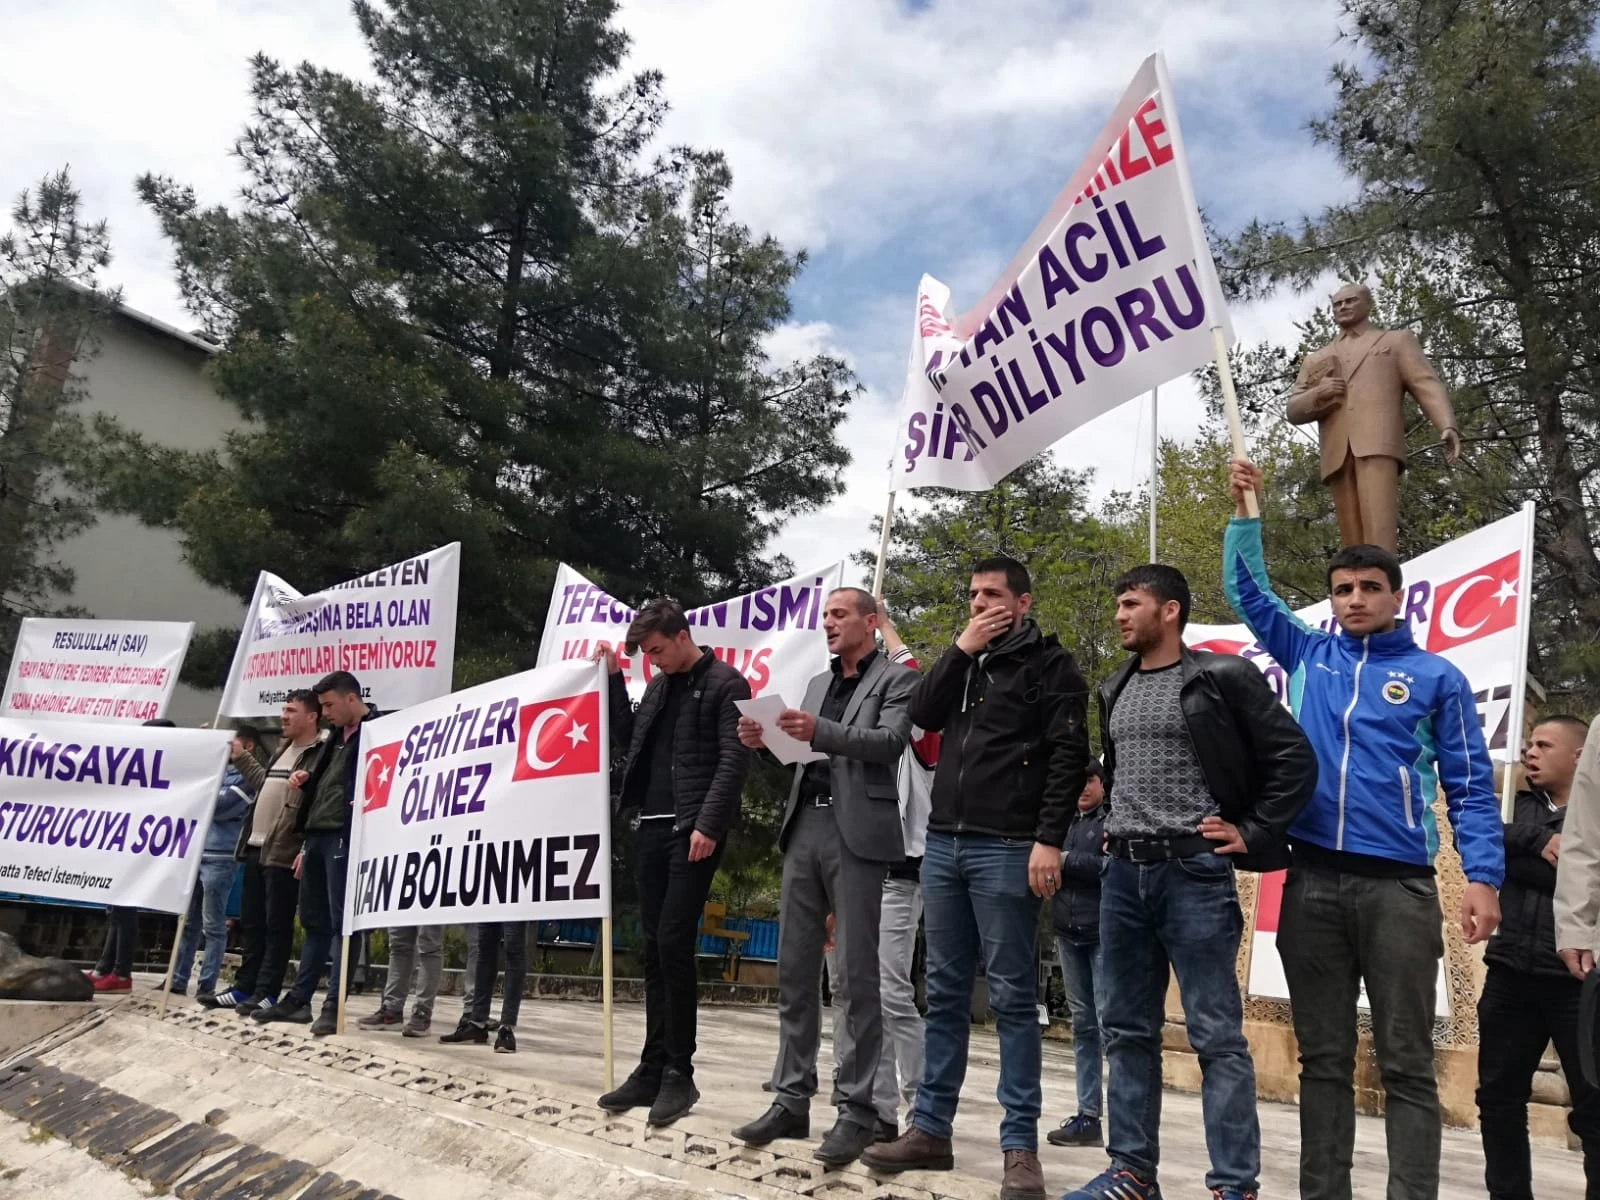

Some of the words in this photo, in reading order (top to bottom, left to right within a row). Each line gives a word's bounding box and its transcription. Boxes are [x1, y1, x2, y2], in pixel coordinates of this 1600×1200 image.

[1038, 195, 1166, 309] ACİL
[971, 259, 1206, 440] DİLİYORU
[346, 602, 383, 630] BELA
[387, 599, 431, 627] OLAN
[53, 632, 118, 651] RESULULLAH
[119, 633, 148, 658] (SAV)
[280, 645, 335, 676] SATICILARI
[338, 636, 437, 672] İSTEMİYORUZ
[0, 733, 171, 789] KİMSAYAL
[399, 696, 519, 777] ŞEHİTLER
[400, 762, 492, 826] ÖLMEZ
[131, 814, 197, 859] SON
[22, 865, 54, 882] Tefeci
[52, 866, 113, 889] İstemiyoruz
[353, 853, 399, 917] TAN
[397, 829, 601, 911] BÖLÜNMEZ
